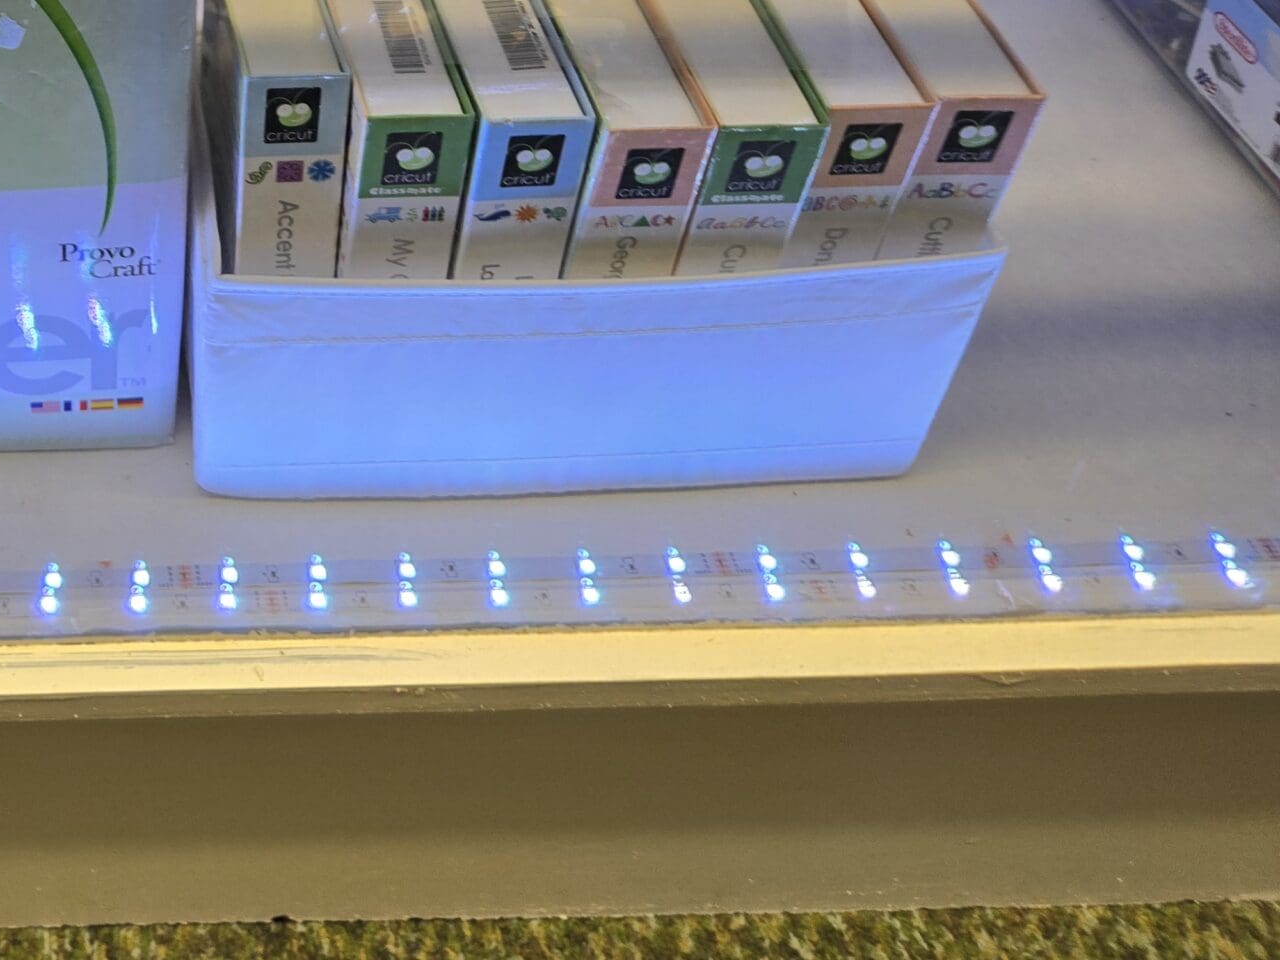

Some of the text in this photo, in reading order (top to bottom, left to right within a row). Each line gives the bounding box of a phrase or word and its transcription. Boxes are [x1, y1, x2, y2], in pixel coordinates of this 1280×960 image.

[266, 129, 313, 142] cricut
[383, 171, 432, 184] cricut
[503, 173, 552, 186] cricut
[727, 179, 777, 191] cricut
[618, 186, 670, 199] cricut
[275, 199, 300, 271] Accent
[58, 243, 136, 263] Provo
[386, 238, 415, 267] My
[89, 255, 158, 279] Craft
